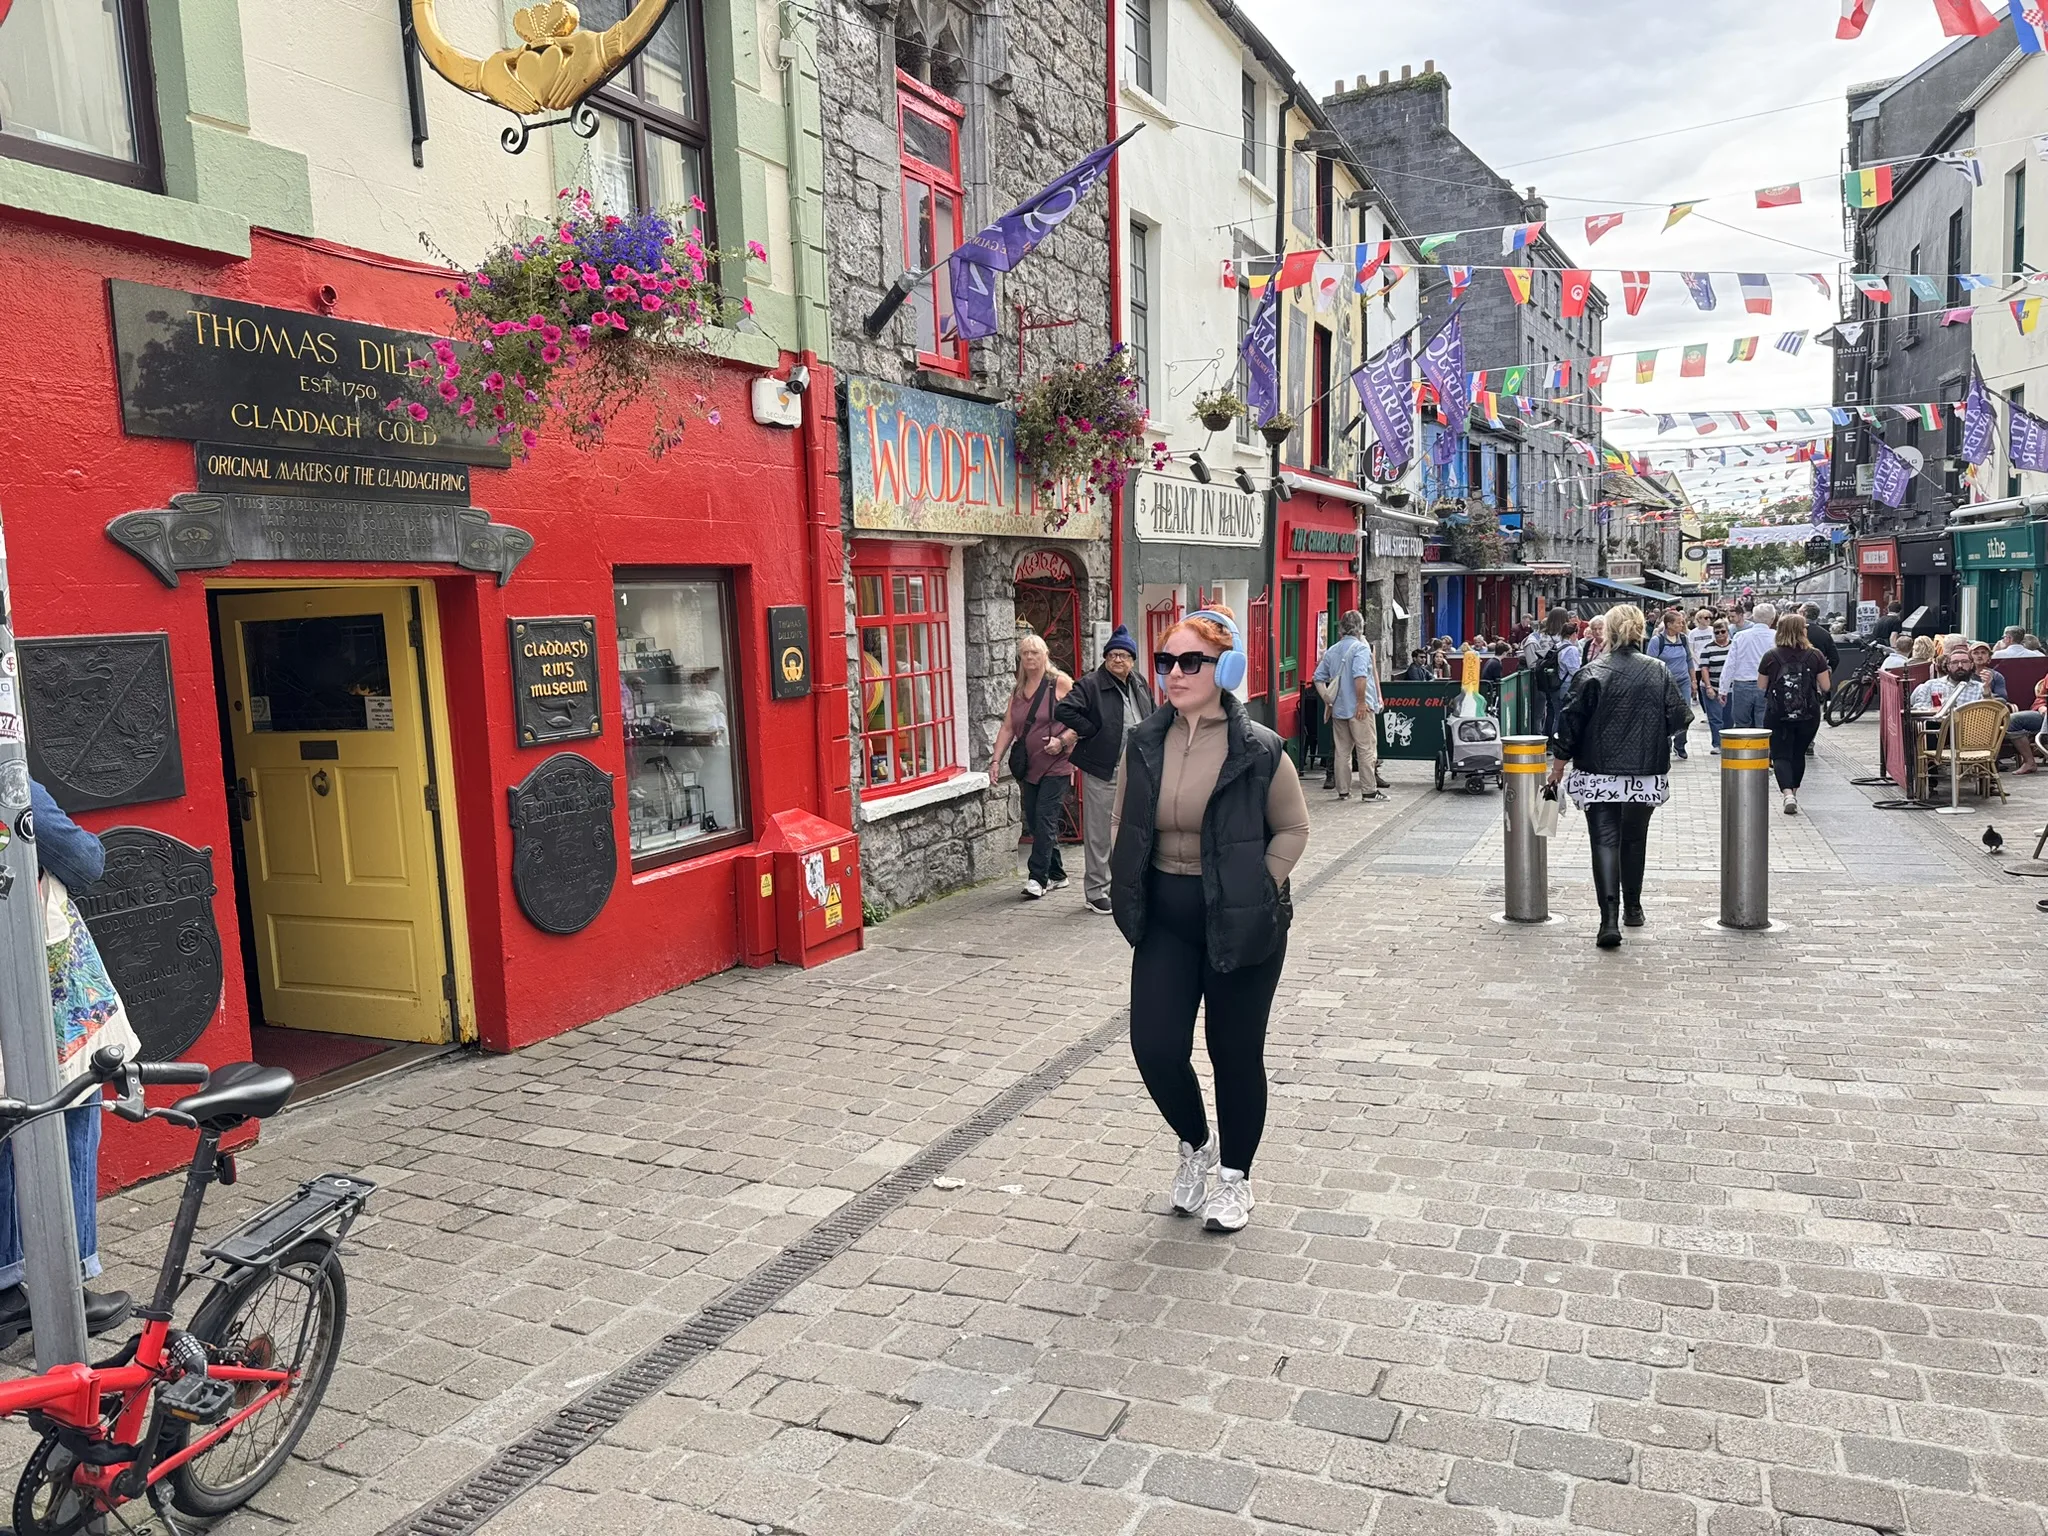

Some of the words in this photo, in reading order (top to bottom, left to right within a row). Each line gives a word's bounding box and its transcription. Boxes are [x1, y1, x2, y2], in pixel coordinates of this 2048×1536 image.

[187, 310, 338, 364] THOMAS
[359, 339, 447, 380] DILLO
[1837, 346, 1867, 354] SNUG
[300, 376, 332, 393] EST.
[342, 382, 377, 400] 1750
[231, 403, 361, 439] CLADDAGH
[379, 420, 437, 446] GOLD
[1844, 371, 1857, 462] HOTEL
[866, 405, 1005, 506] WOODEN
[208, 455, 271, 479] ORIGINAL
[275, 461, 333, 483] MAKERS
[335, 464, 351, 484] OF
[354, 466, 375, 486] THE
[378, 468, 438, 491] CLADDAGH
[441, 473, 466, 492] RING
[235, 496, 264, 510] THIS
[268, 497, 358, 516] ESTABLISHMENT
[363, 503, 372, 515] IS
[375, 503, 432, 518] DEDICATED
[435, 506, 450, 519] TO
[1151, 482, 1198, 535] HEART
[1201, 489, 1215, 535] IN
[1218, 492, 1256, 539] HANDS
[261, 514, 288, 528] FAIR
[291, 515, 320, 528] PLAY
[323, 516, 347, 529] AND
[351, 518, 359, 530] A
[362, 518, 404, 532] SQUARE
[408, 520, 433, 533] DEAL
[264, 530, 285, 544] NO
[290, 531, 317, 544] MAN
[321, 532, 366, 546] SHOULD
[370, 534, 410, 547] EXPECT
[412, 535, 432, 548] LESS
[1293, 527, 1306, 551] THE
[1308, 530, 1338, 553] CHARCOAL
[296, 548, 322, 560] NOR
[325, 549, 339, 560] BE
[343, 549, 377, 561] GIVEN
[382, 549, 411, 562] MORE
[1384, 698, 1420, 706] ARCOAL
[1425, 698, 1443, 707] GRI
[143, 883, 161, 903] &
[165, 874, 201, 899] SON
[145, 907, 175, 925] GOLD
[123, 964, 181, 990] CLADDAGH
[184, 956, 212, 975] RING
